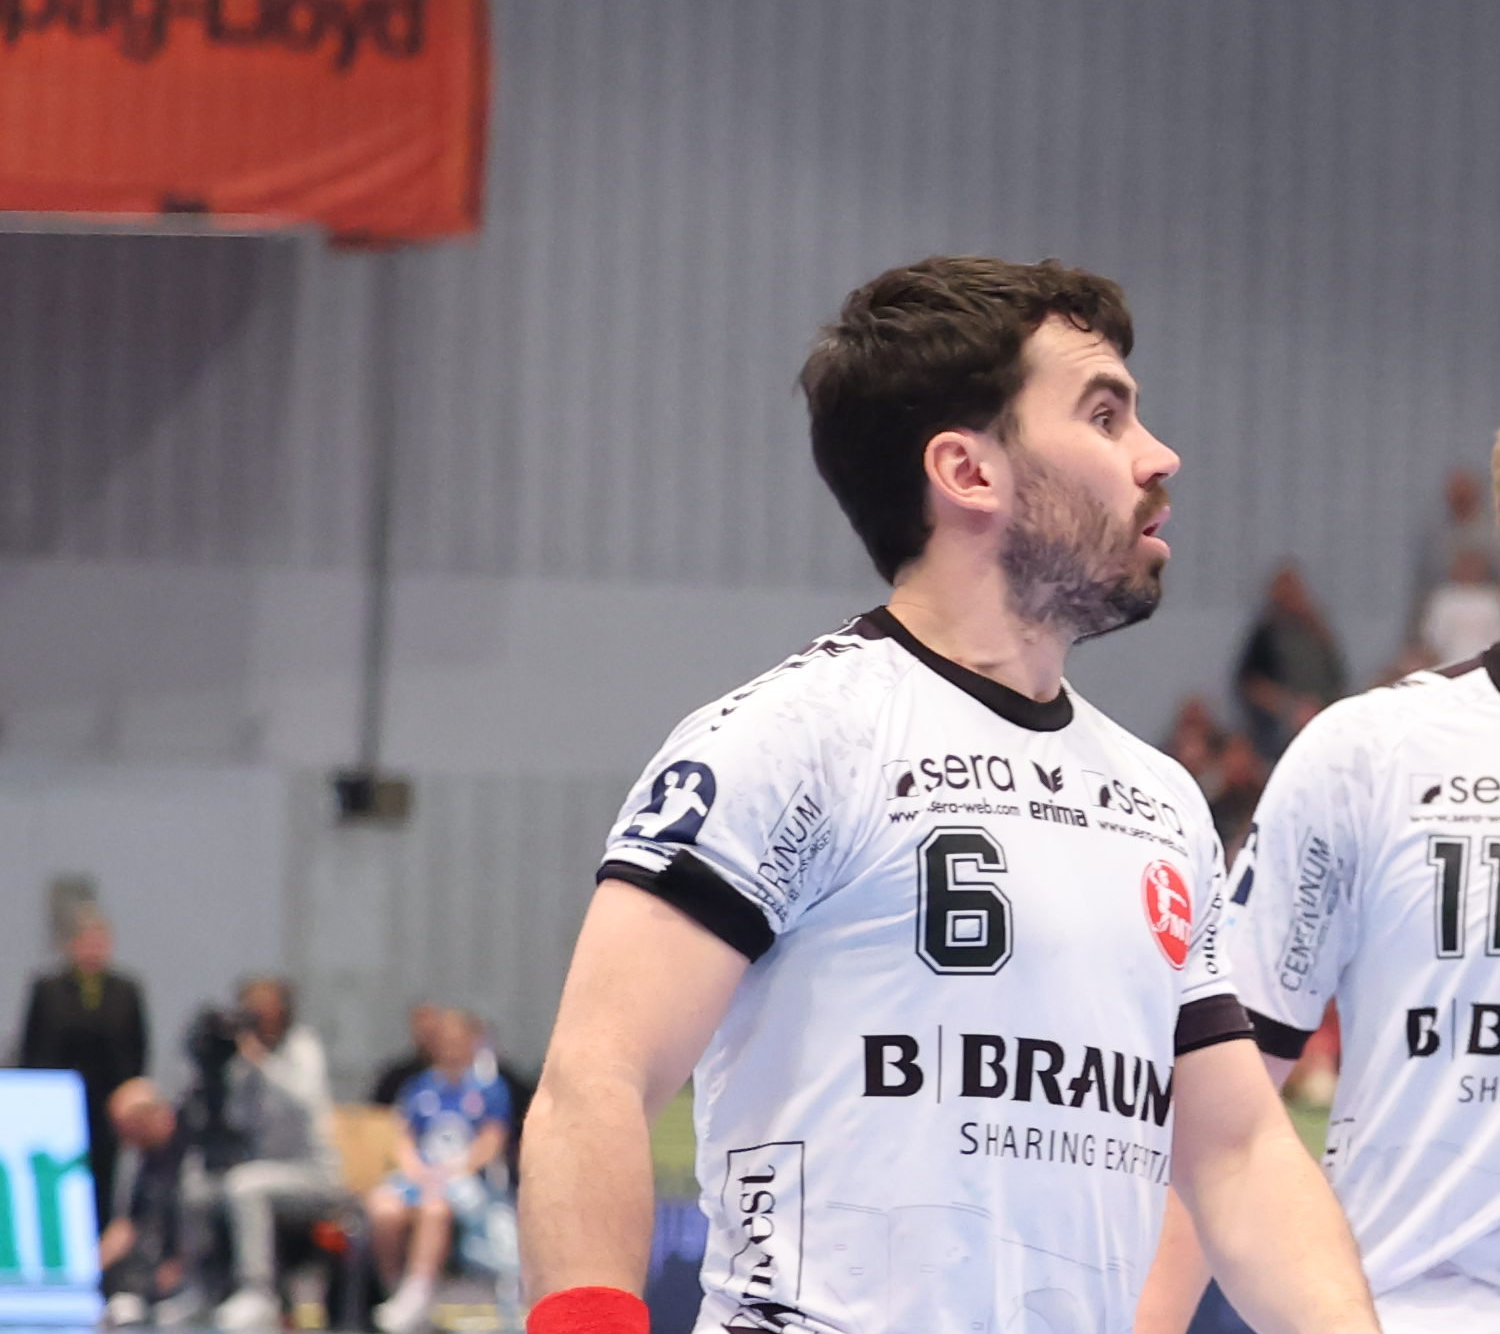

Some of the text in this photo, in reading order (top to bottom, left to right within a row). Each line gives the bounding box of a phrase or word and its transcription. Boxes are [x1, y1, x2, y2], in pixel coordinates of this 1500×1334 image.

[920, 753, 1017, 793] sera
[1029, 799, 1089, 828] erima
[1112, 779, 1187, 838] sera
[915, 825, 1014, 976] 6
[861, 1033, 1174, 1127] B BRAUN
[959, 1121, 1097, 1167] SHARING
